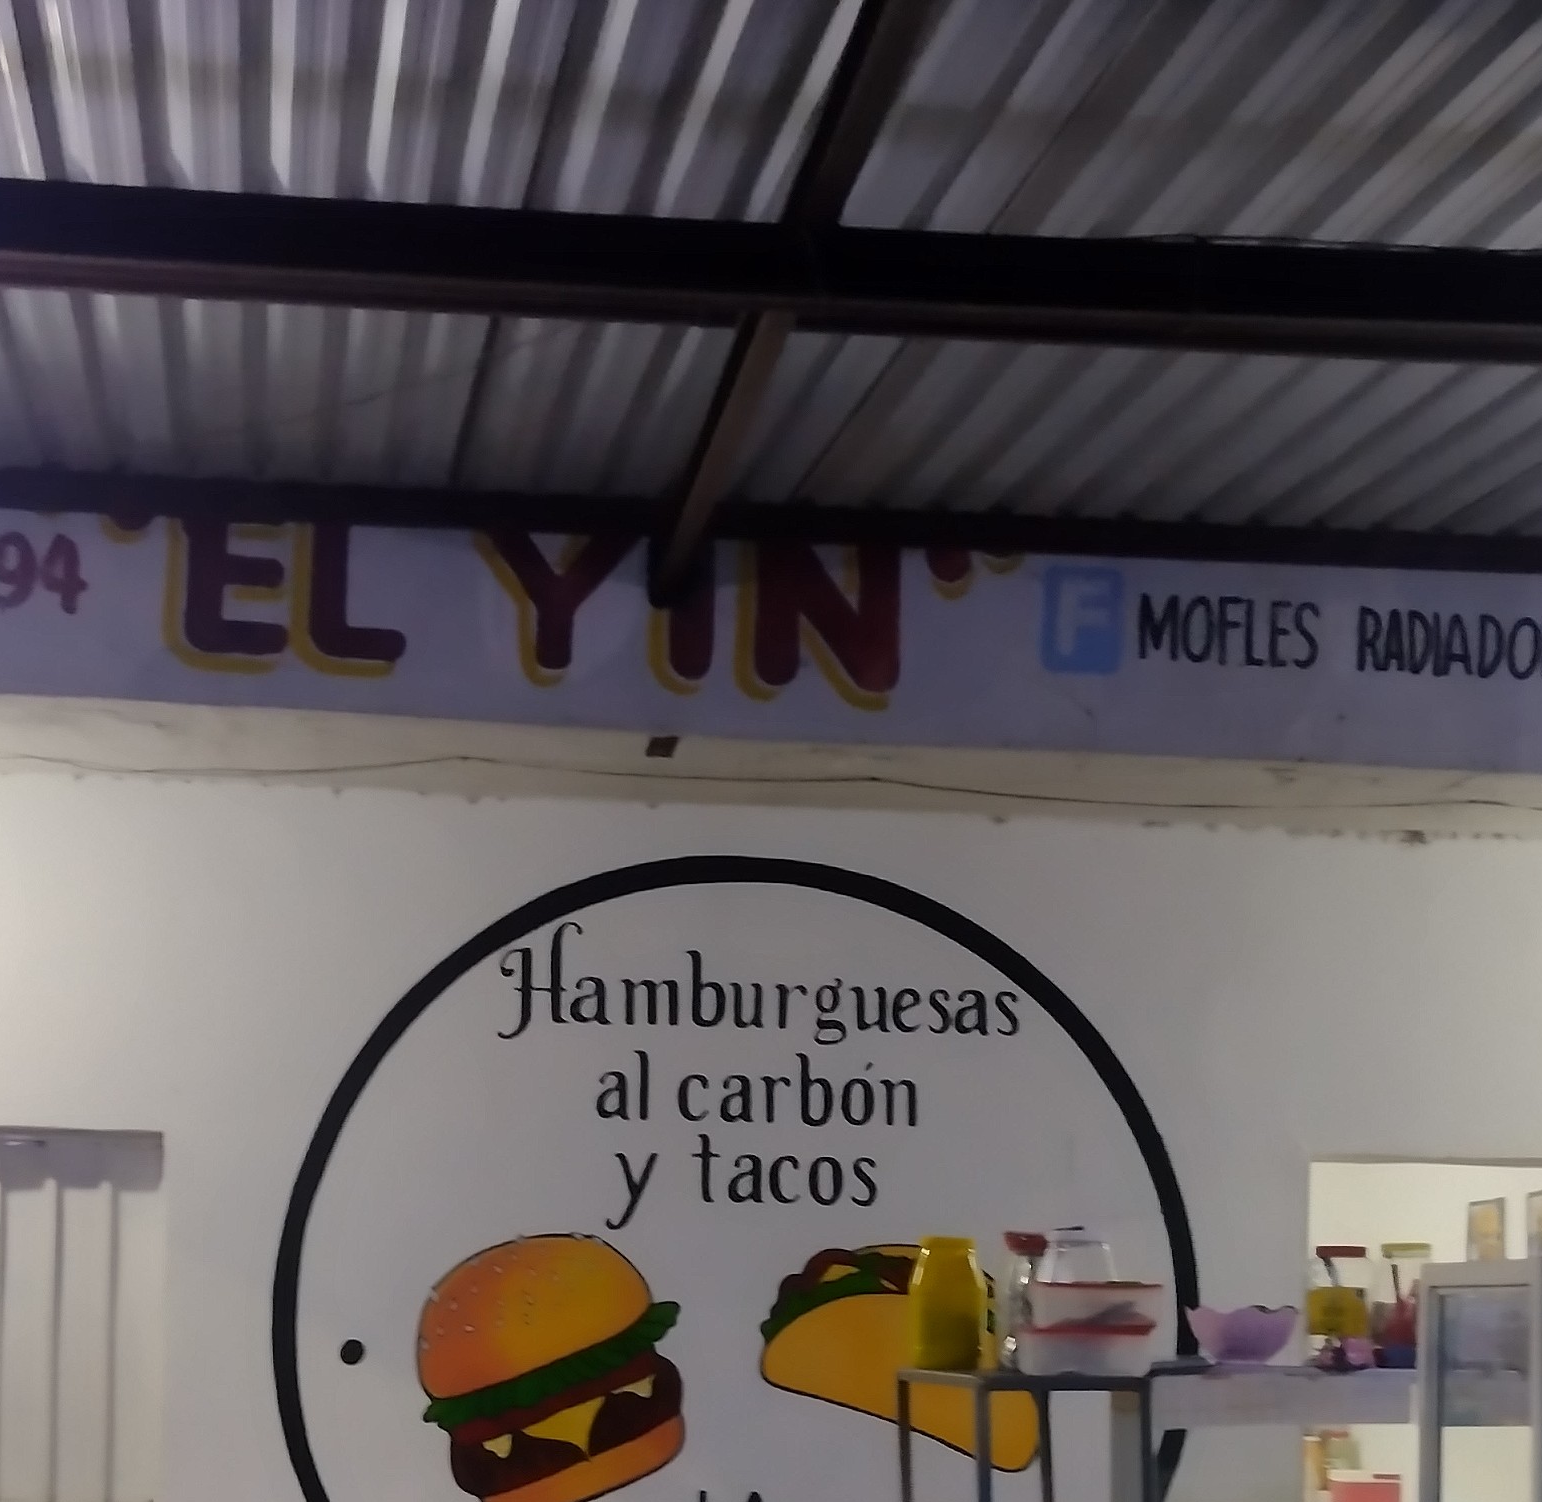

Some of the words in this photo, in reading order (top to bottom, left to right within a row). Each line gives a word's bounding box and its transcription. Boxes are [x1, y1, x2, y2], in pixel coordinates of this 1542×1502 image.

[162, 519, 407, 677] EL
[469, 530, 902, 711] YIN
[1136, 592, 1321, 670] MOFLES
[497, 922, 1021, 1046] Hamburguesas
[595, 1050, 651, 1121] al
[676, 1053, 920, 1127] carbón
[605, 1151, 659, 1230] y
[691, 1134, 880, 1207] tacos
